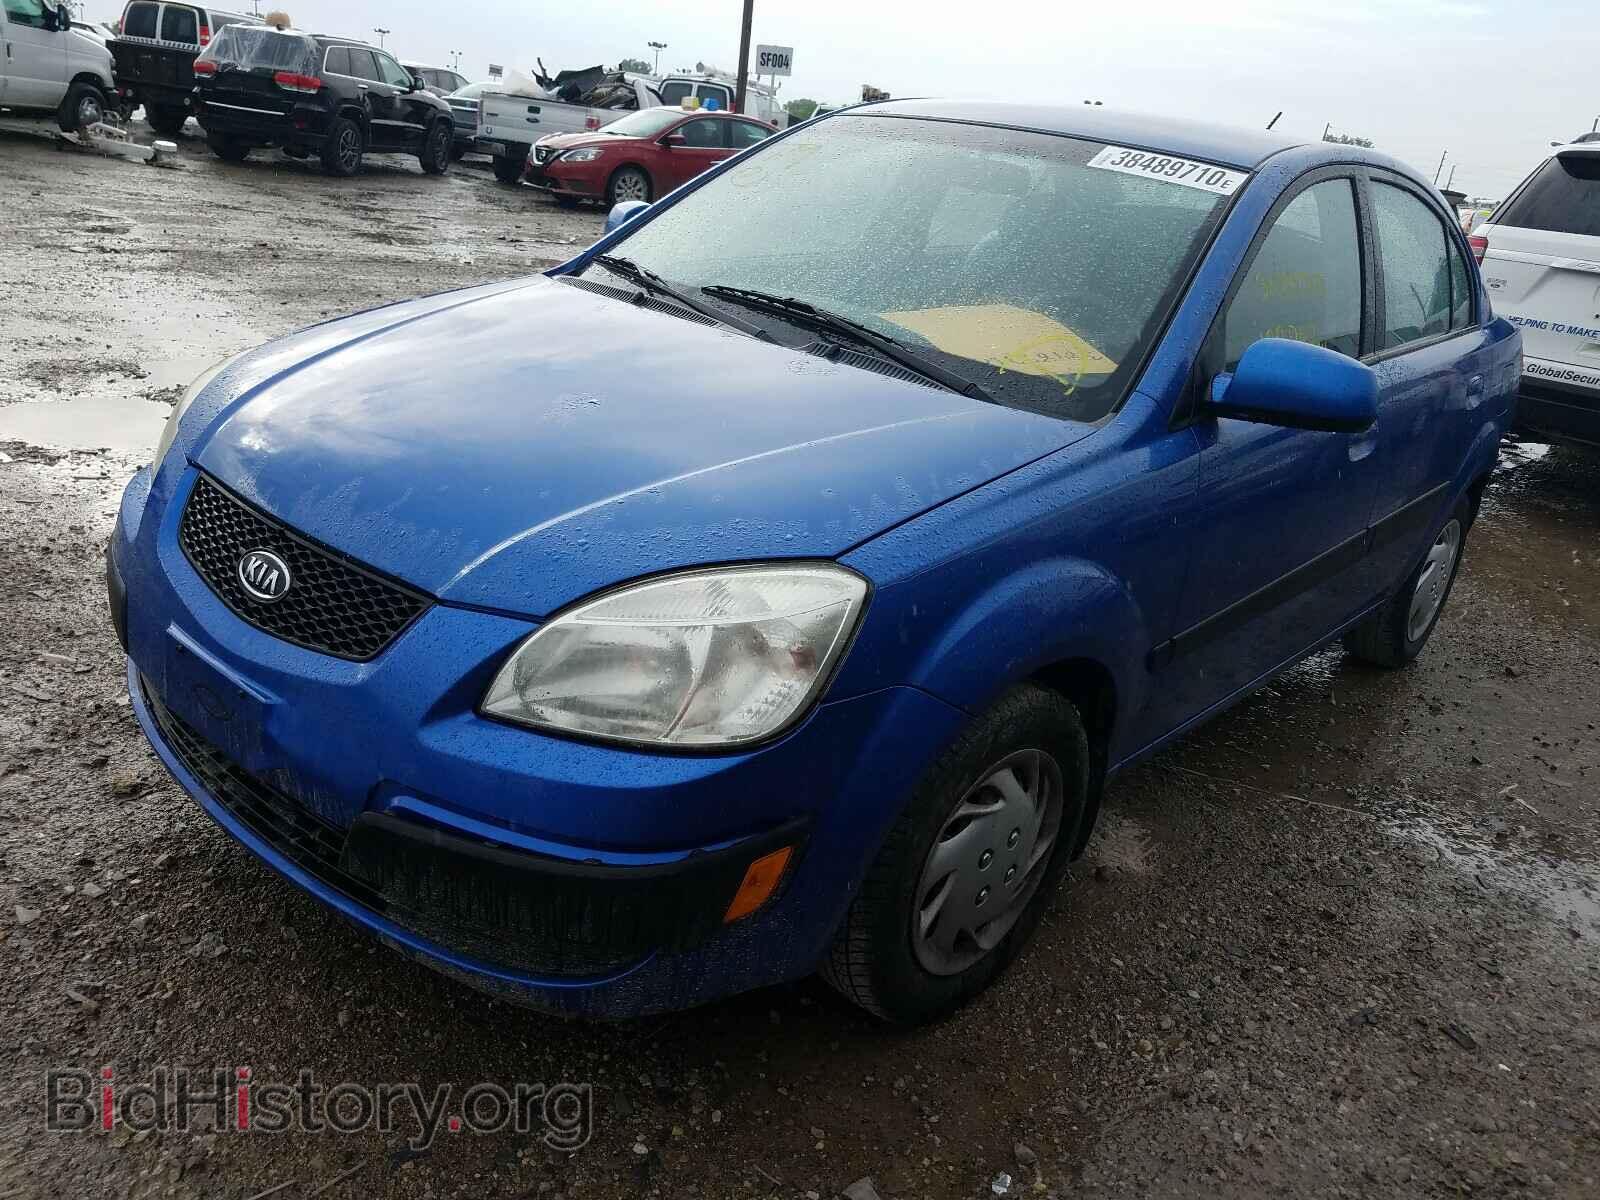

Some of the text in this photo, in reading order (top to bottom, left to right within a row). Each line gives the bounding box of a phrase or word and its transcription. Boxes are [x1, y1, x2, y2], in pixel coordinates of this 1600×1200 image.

[759, 52, 789, 69] SF004
[1508, 315, 1600, 338] HELPING TO MAKE
[245, 556, 279, 594] KIA
